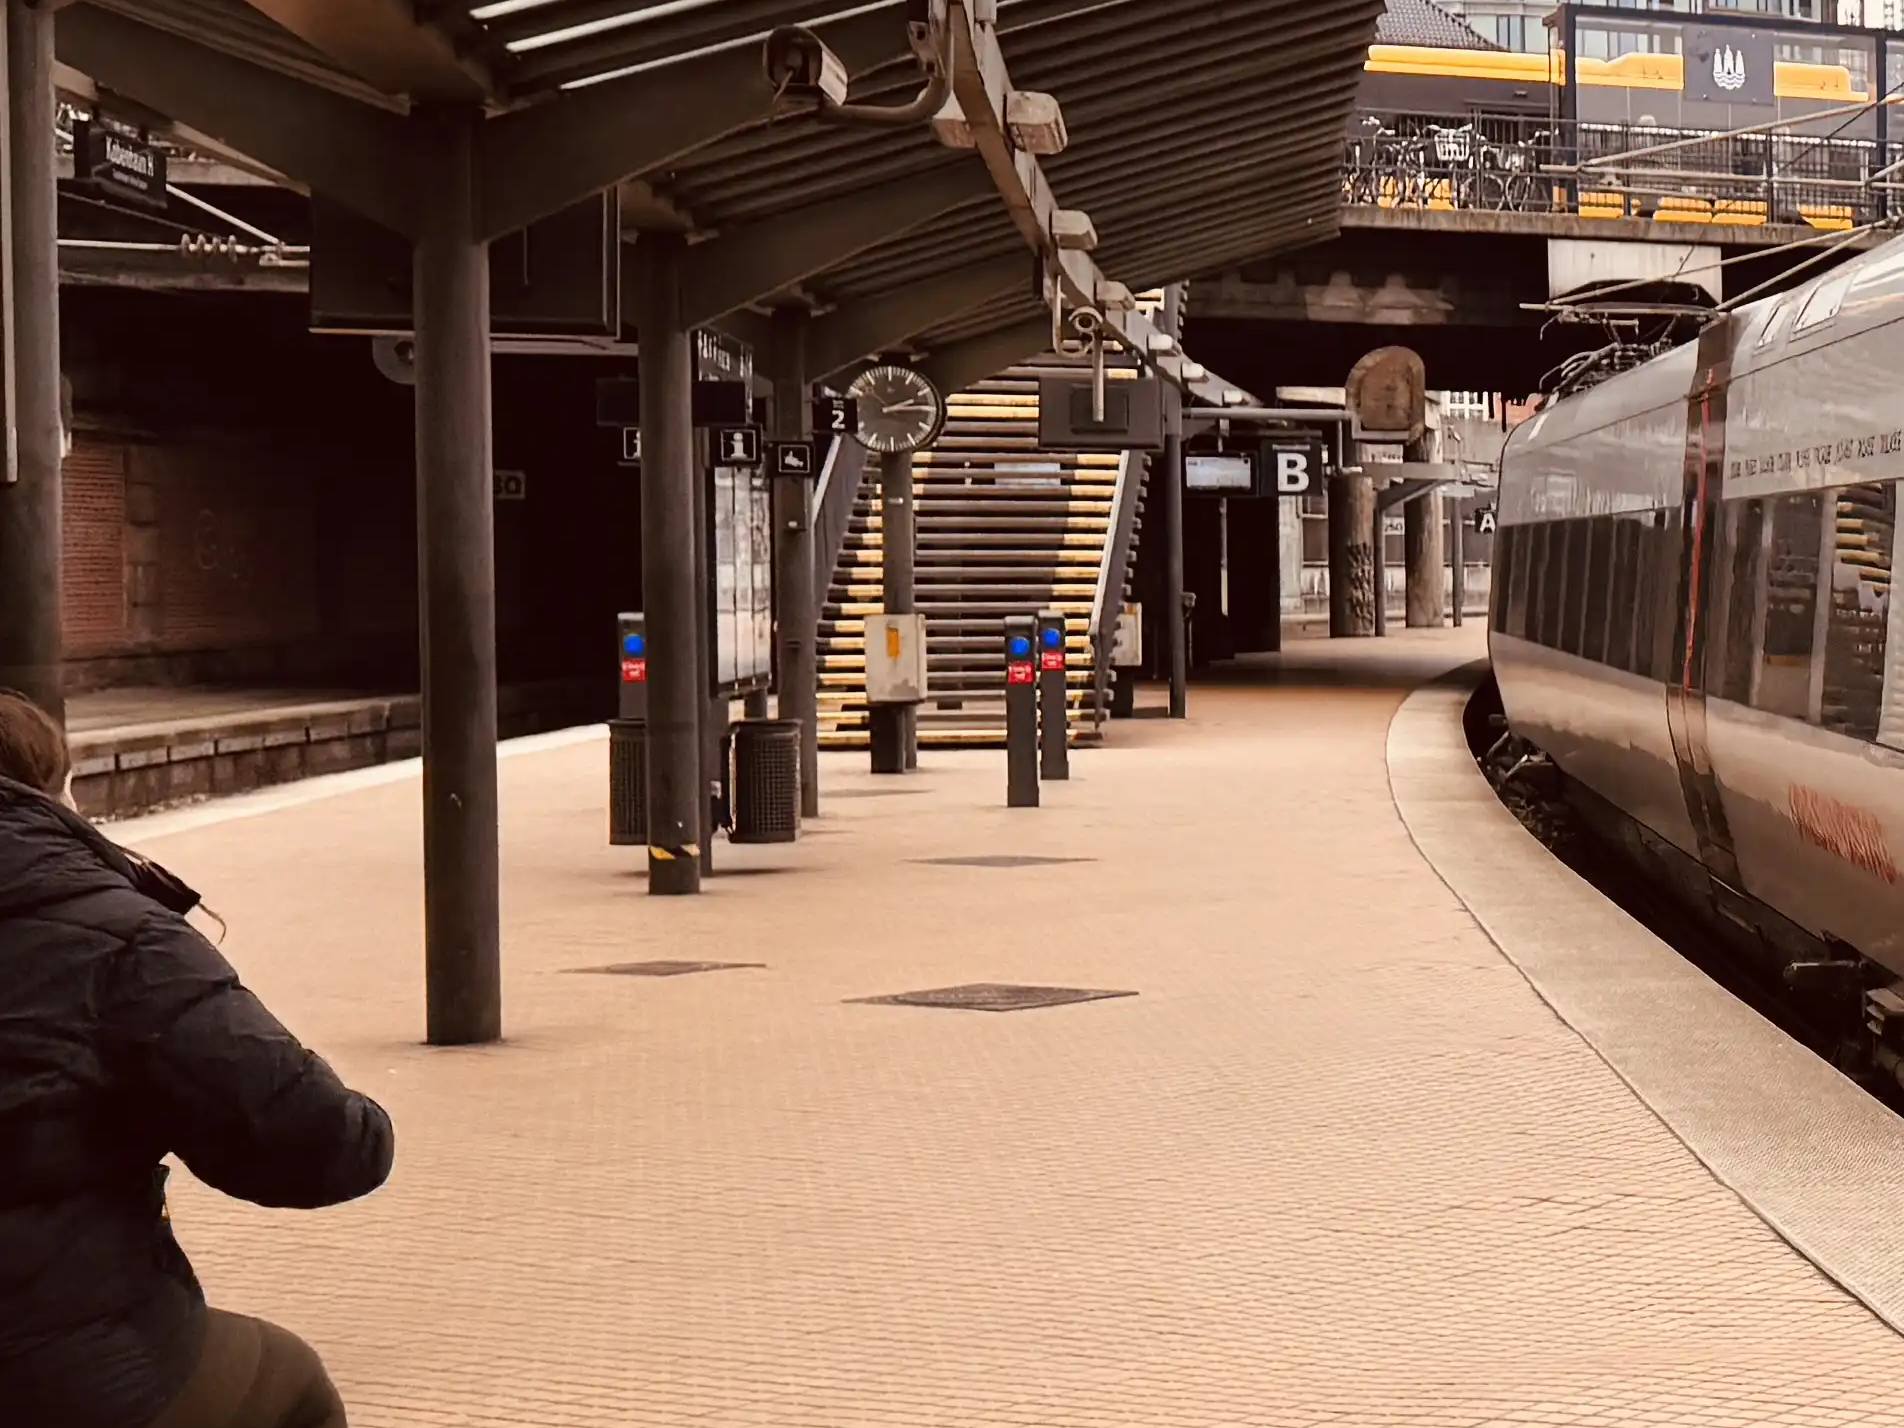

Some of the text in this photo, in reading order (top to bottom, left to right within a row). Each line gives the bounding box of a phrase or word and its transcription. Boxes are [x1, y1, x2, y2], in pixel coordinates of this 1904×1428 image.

[832, 410, 845, 429] 2
[1277, 453, 1309, 492] B
[1480, 512, 1496, 533] A
